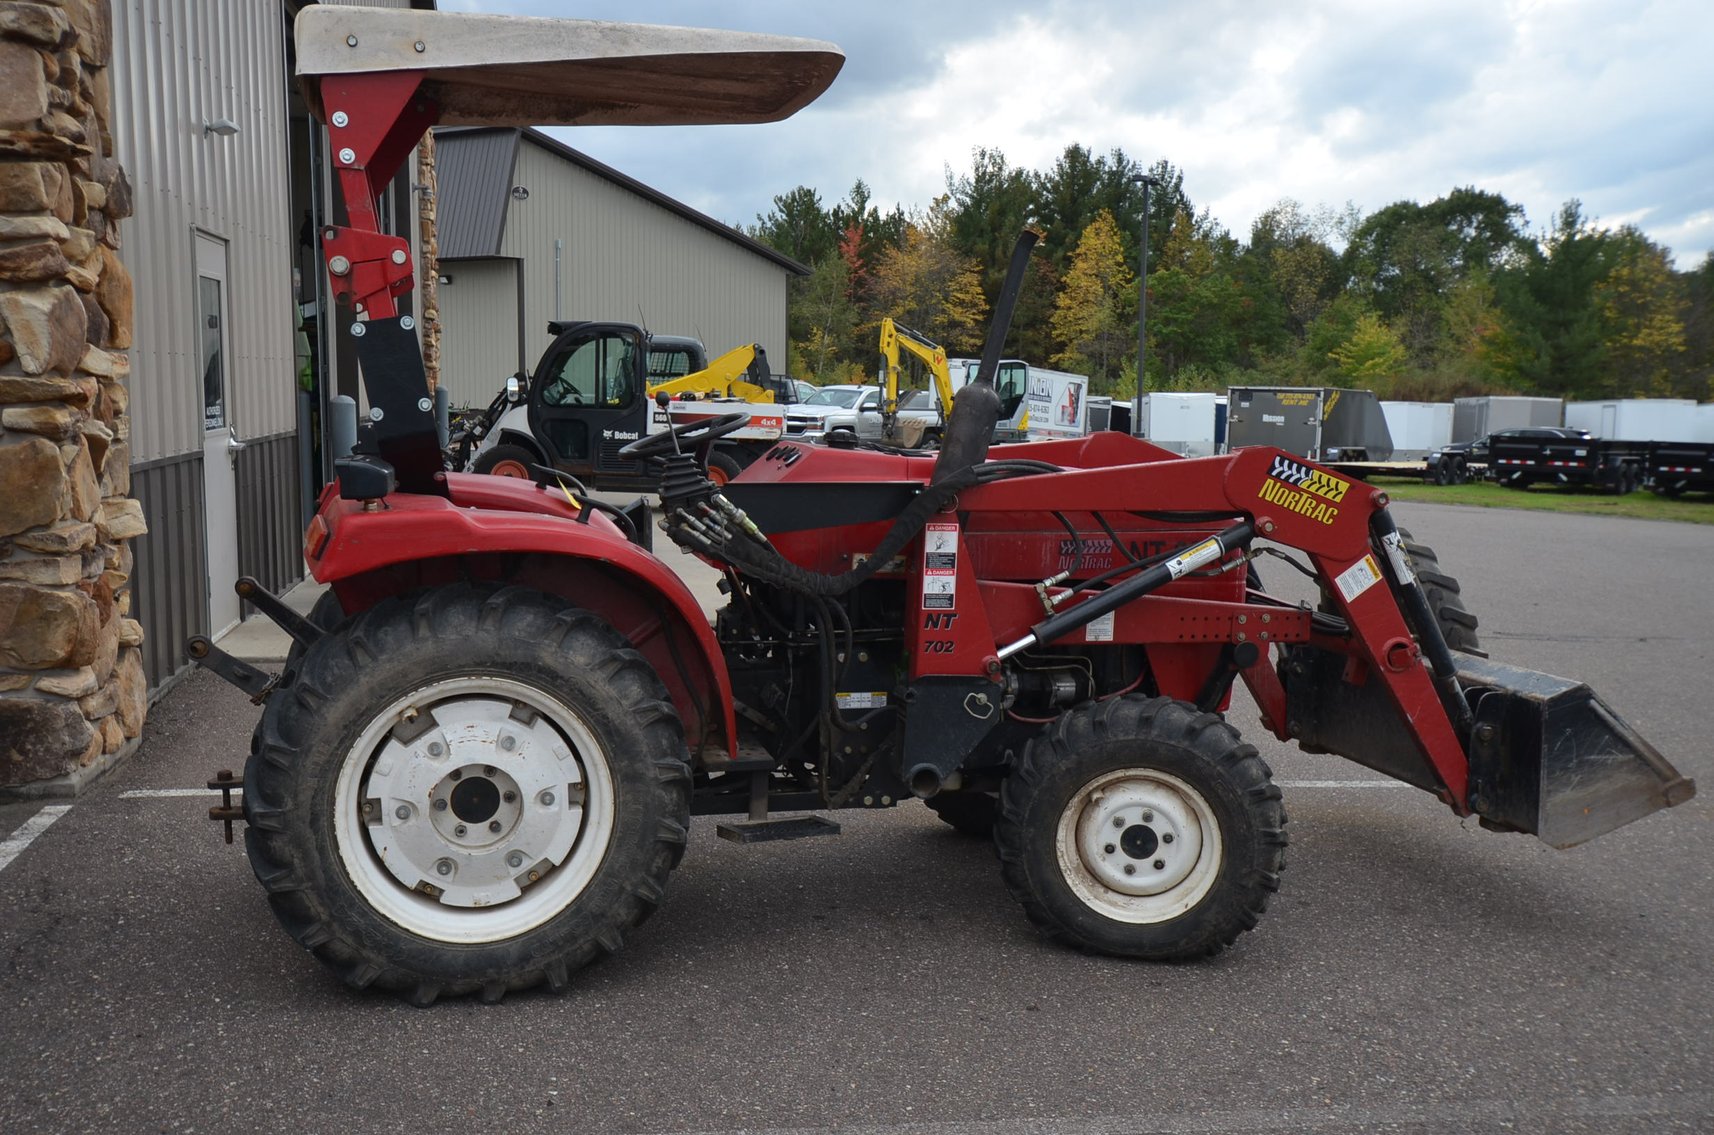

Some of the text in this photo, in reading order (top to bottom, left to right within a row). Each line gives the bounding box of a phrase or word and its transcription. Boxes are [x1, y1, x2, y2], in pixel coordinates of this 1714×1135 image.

[614, 430, 639, 440] Bobcat
[924, 613, 959, 631] NT
[924, 640, 955, 654] 702
